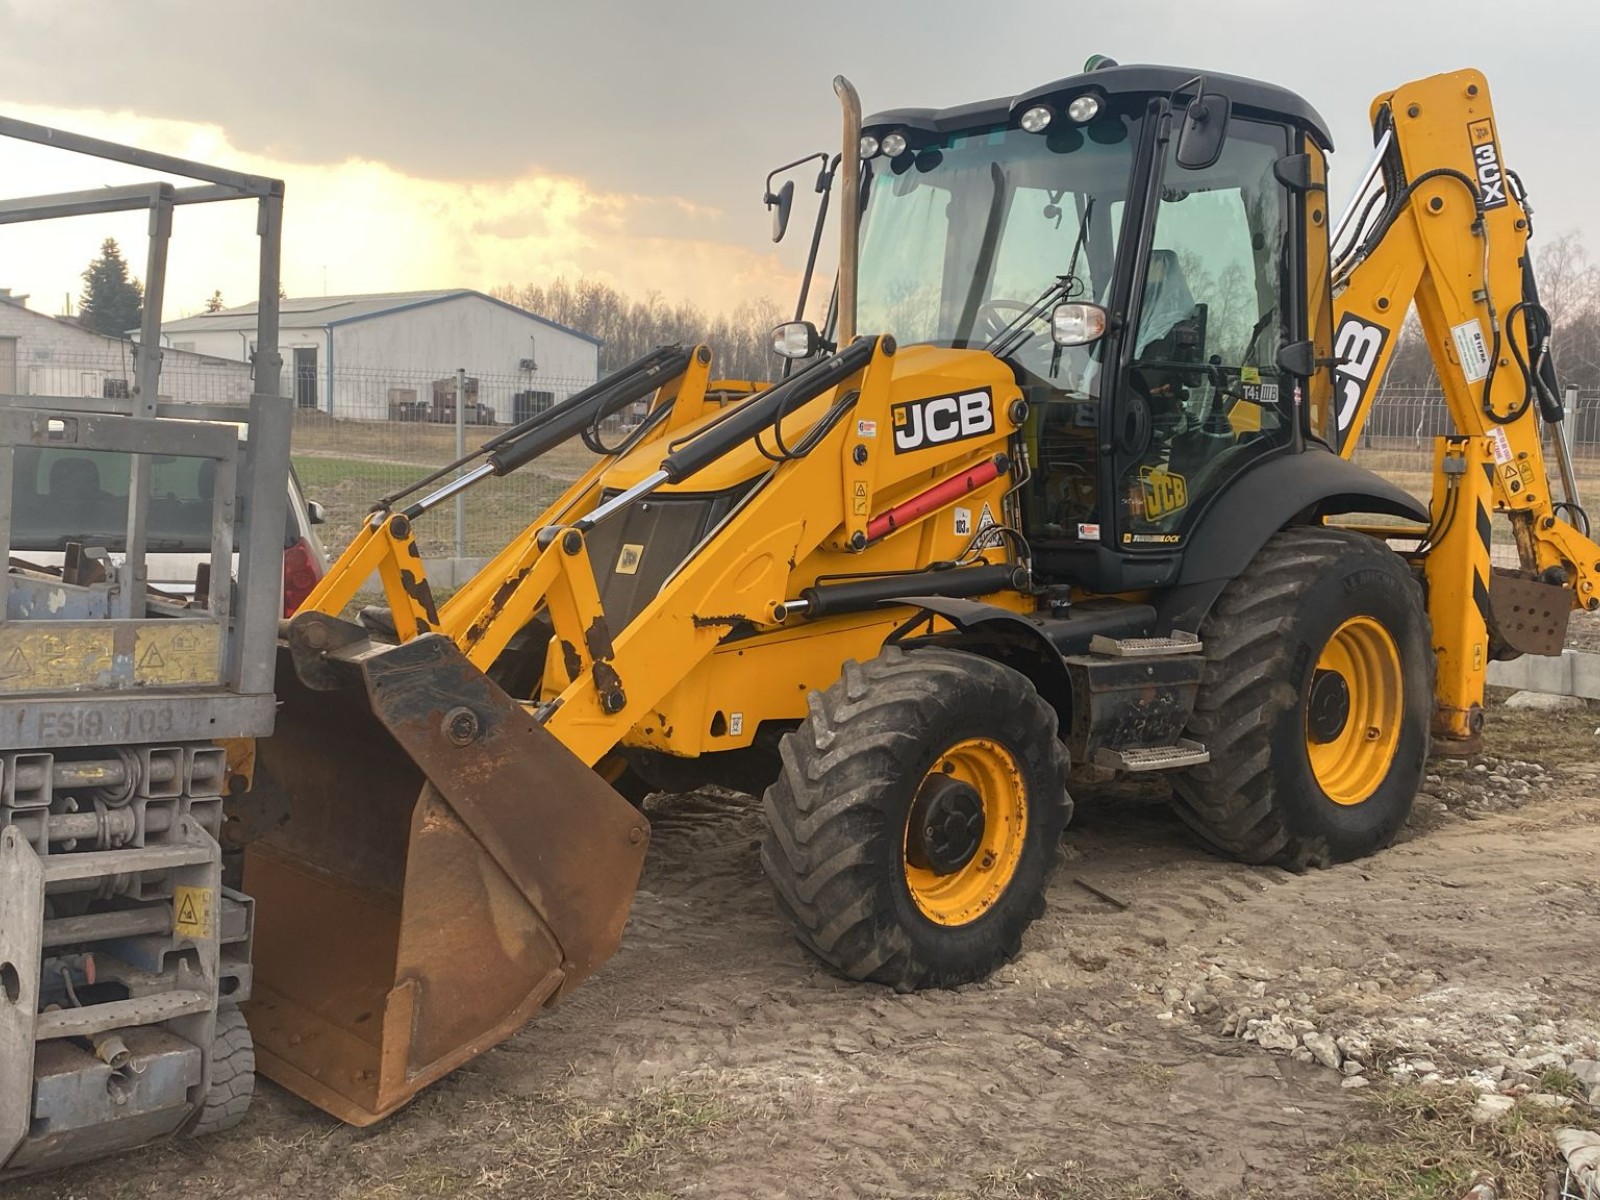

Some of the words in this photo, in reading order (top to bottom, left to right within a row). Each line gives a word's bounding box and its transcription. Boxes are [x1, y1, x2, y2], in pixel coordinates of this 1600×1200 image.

[1475, 144, 1506, 203] 3CX
[1334, 320, 1382, 431] CB
[896, 391, 993, 449] JCB
[1146, 471, 1186, 516] JCB
